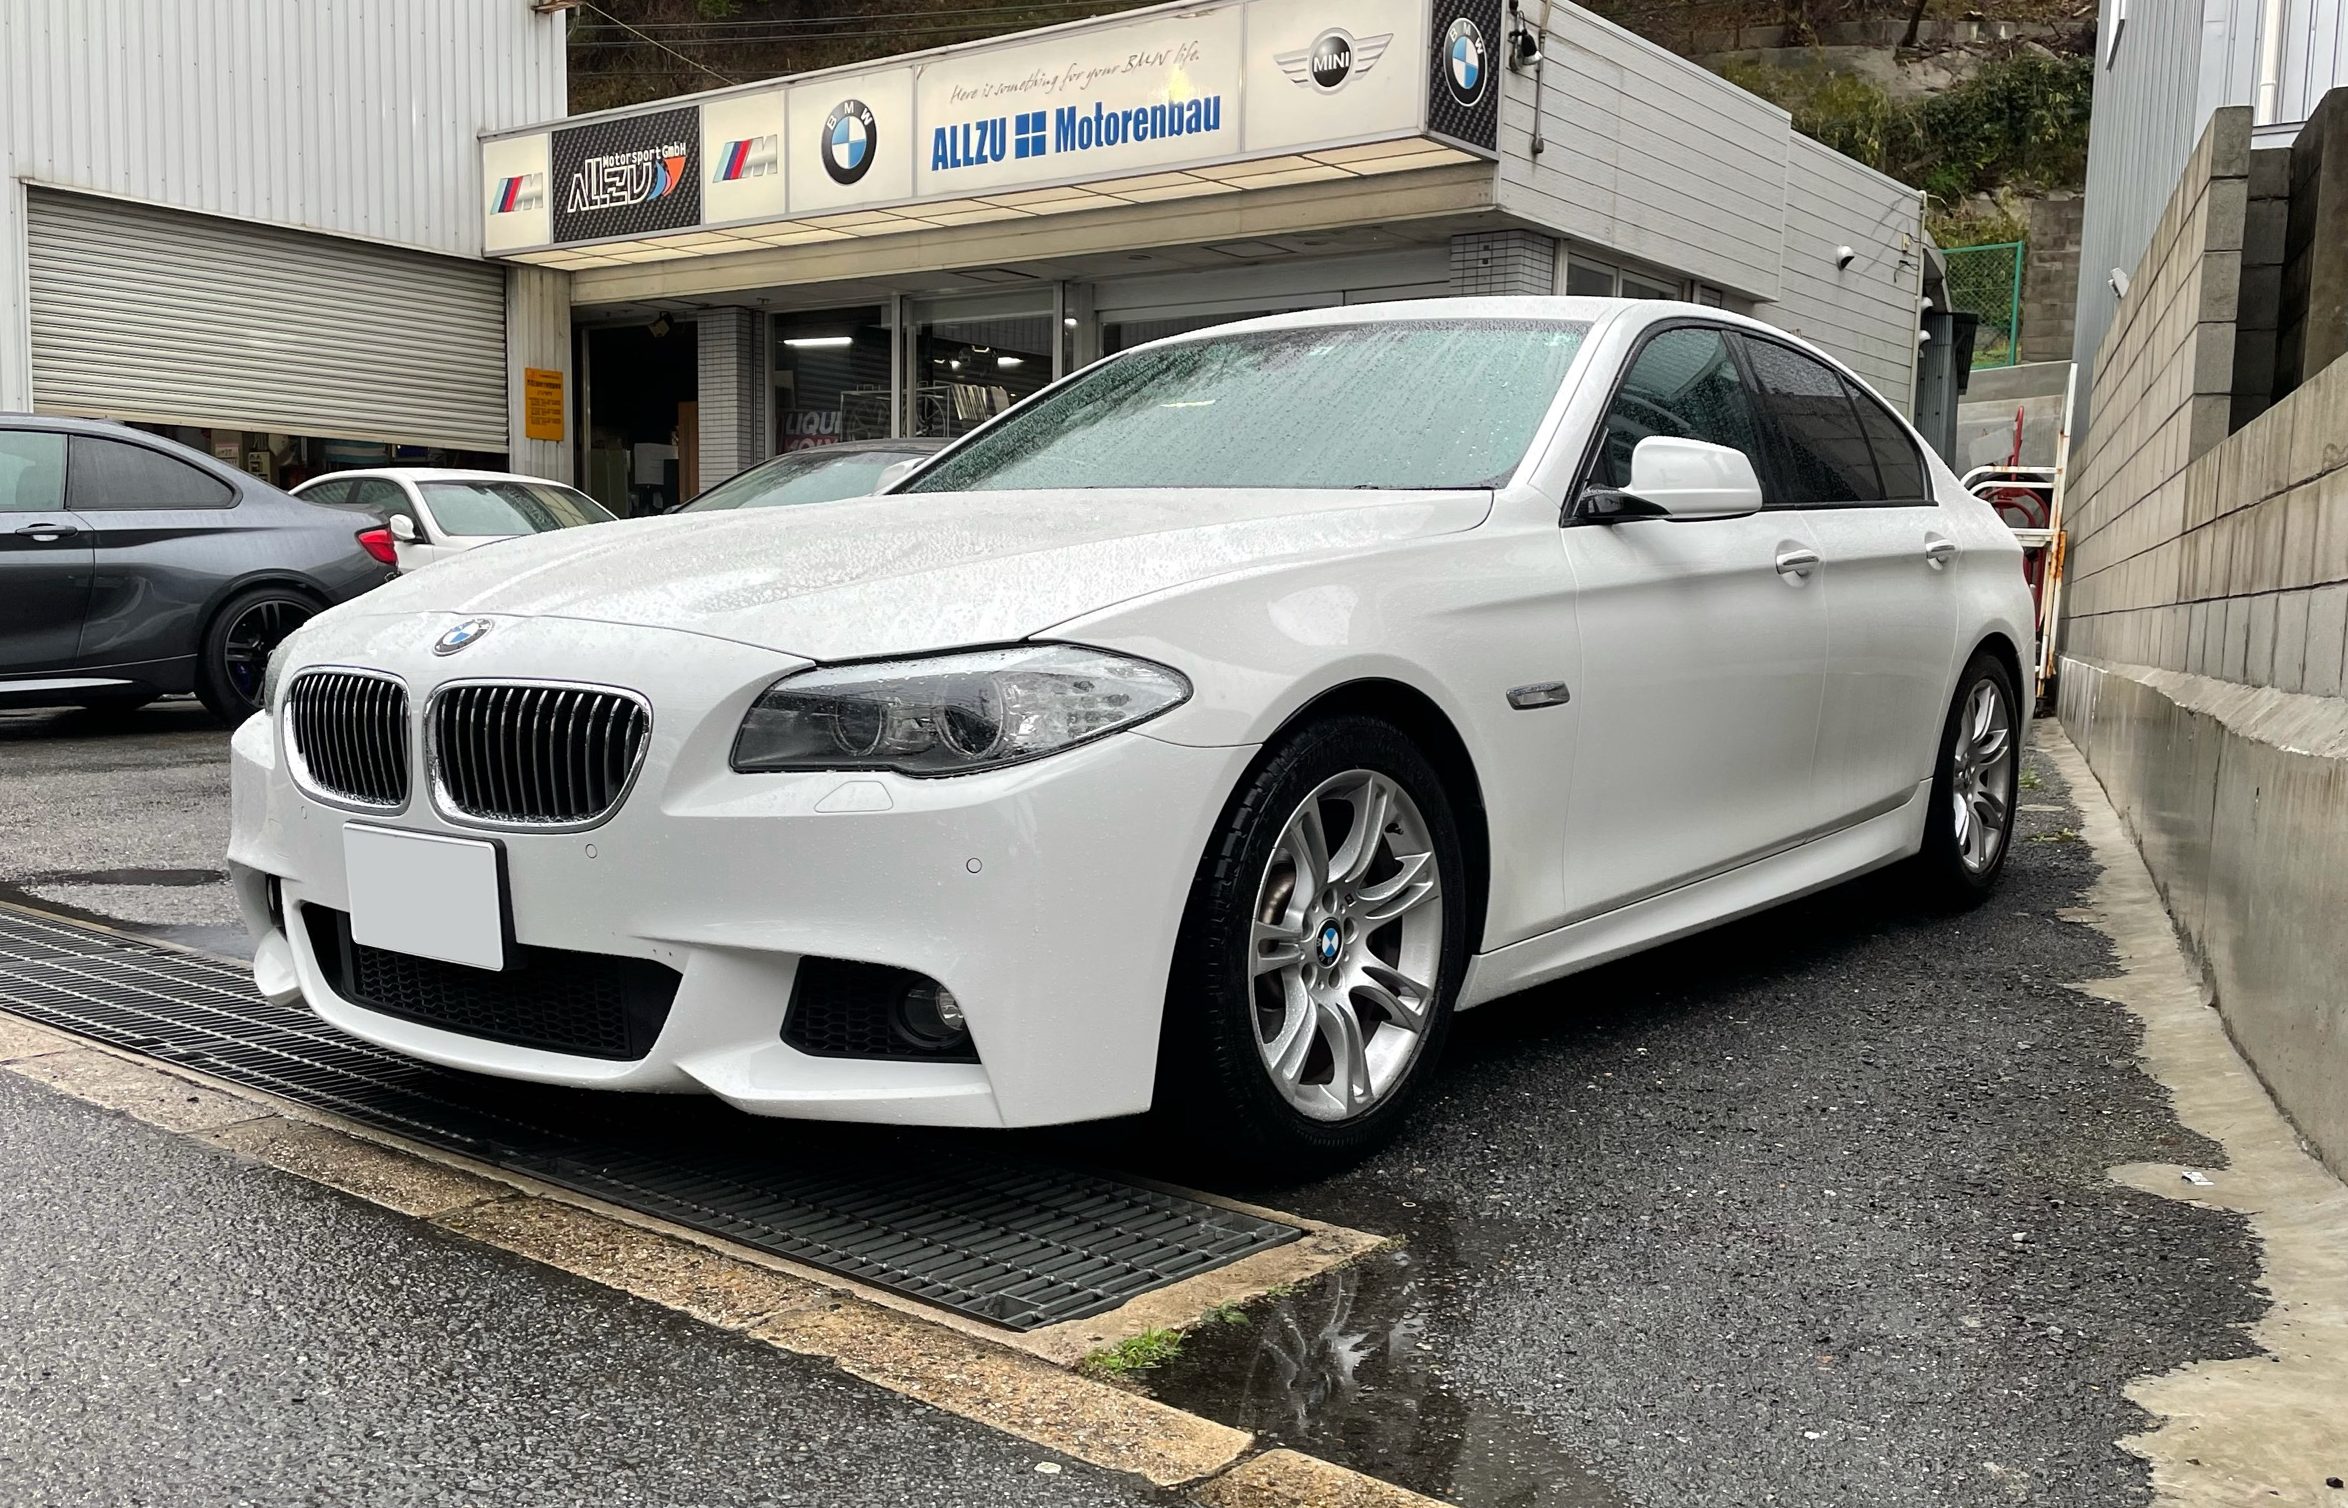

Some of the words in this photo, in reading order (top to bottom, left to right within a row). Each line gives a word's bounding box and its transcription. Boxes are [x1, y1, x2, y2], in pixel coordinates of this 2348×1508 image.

[1449, 21, 1484, 55] BMW
[950, 84, 979, 104] Here
[983, 82, 994, 98] is
[994, 67, 1059, 96] something
[1058, 62, 1084, 92] for
[1080, 65, 1121, 91] your
[1121, 49, 1173, 74] BMW
[1313, 50, 1350, 73] MINI
[826, 100, 873, 131] BMW
[931, 116, 1007, 171] ALLZU
[1055, 91, 1221, 153] Motorenbau
[602, 146, 661, 169] Motorsport
[661, 140, 687, 159] GmbH
[785, 410, 842, 436] LIQUI
